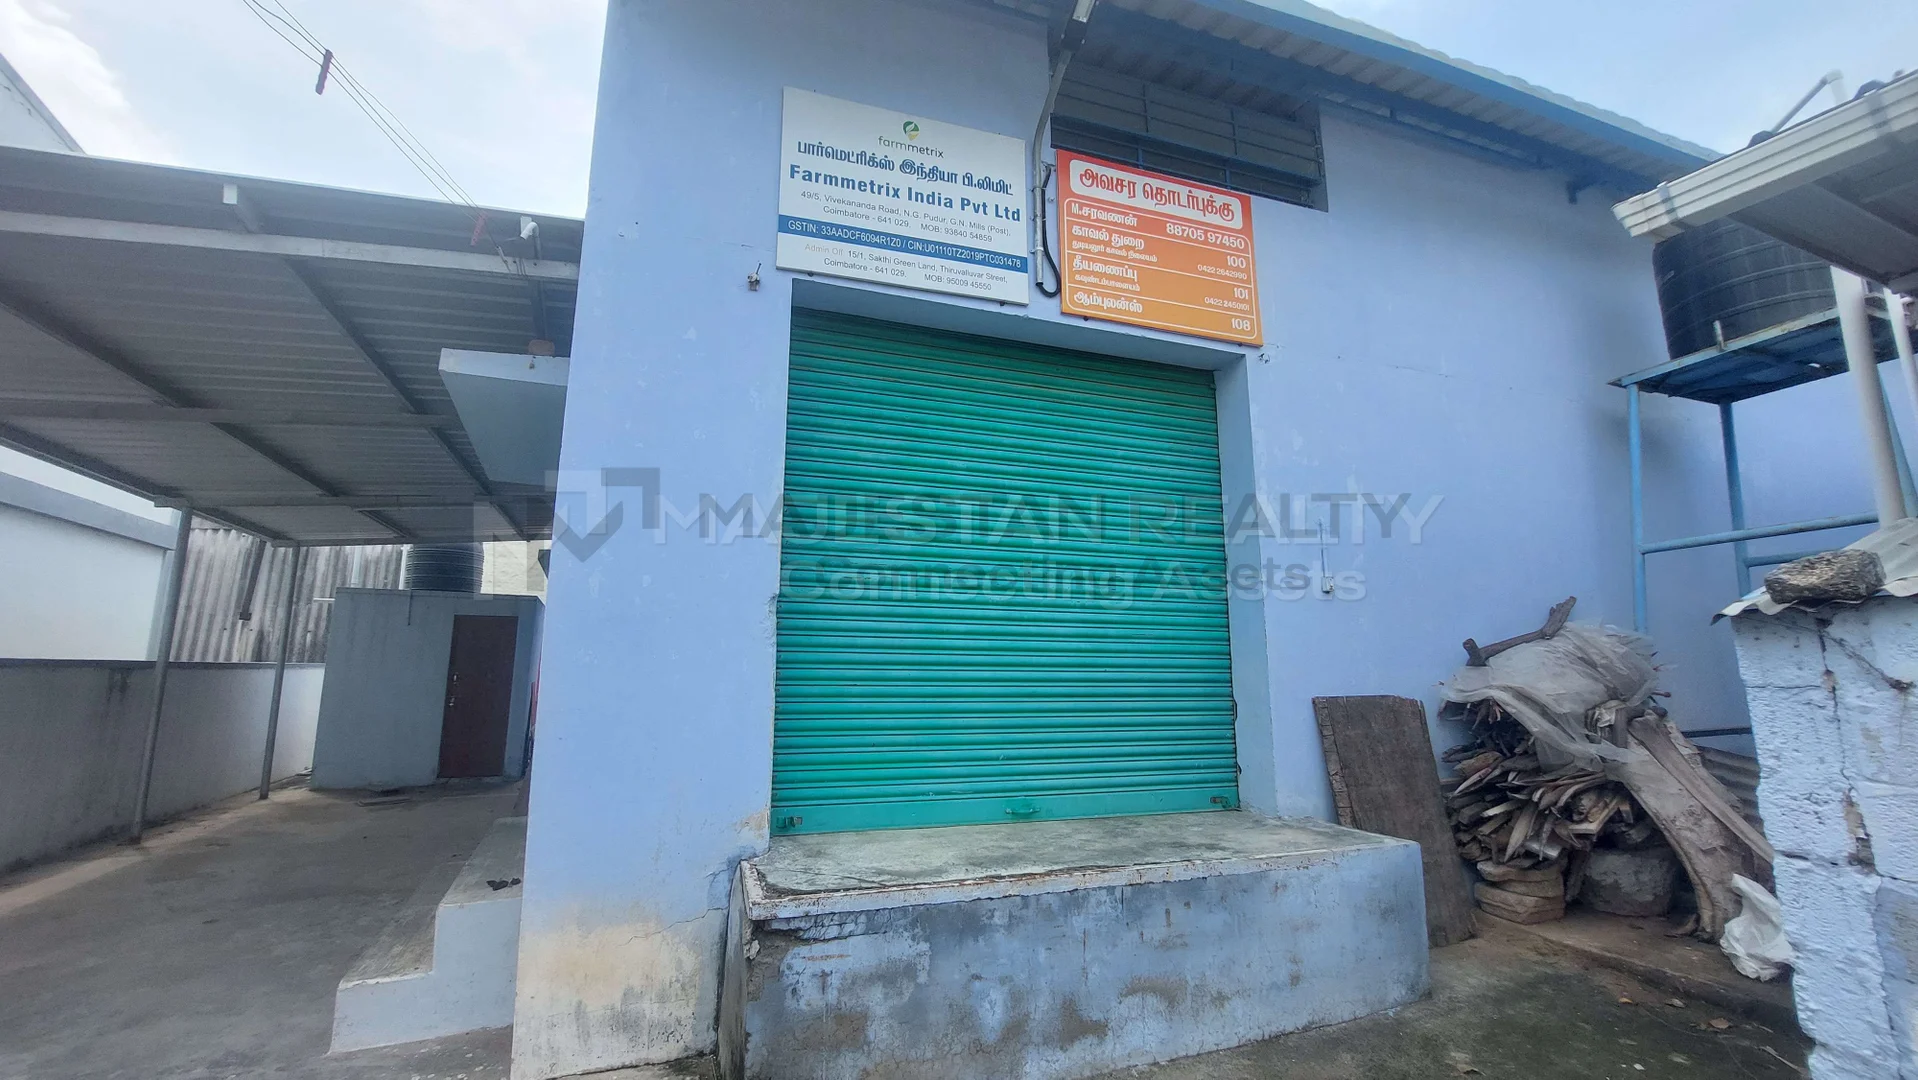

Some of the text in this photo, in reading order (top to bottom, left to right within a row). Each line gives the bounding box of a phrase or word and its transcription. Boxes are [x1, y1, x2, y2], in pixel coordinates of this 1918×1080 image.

[878, 136, 944, 158] farmmetrix
[899, 159, 958, 184] இந்தியா
[789, 164, 1021, 222] Farmmetrix India Pvt Ltd
[1080, 168, 1235, 222] அவசர தொடர்புக்கு
[801, 190, 822, 202] 49/5,
[824, 195, 876, 211] Vivekananda
[878, 204, 901, 216] Road,
[969, 221, 986, 231] Mills
[788, 220, 819, 233] GSTIN:
[823, 206, 870, 221] Coimbatore
[877, 216, 892, 224] 641
[920, 223, 942, 233] MOB:
[970, 231, 993, 242] 54859
[1072, 224, 1145, 250] காவல் துறை
[1166, 223, 1245, 249] 88705 97450
[804, 243, 831, 254] Admin
[868, 253, 892, 264] Sakthi
[893, 258, 916, 268] Green
[940, 264, 984, 279] Thiruvalluvar
[824, 257, 868, 272] Coimbatore
[875, 265, 888, 274] 641
[924, 273, 945, 283] MOB:
[946, 276, 969, 287] 95009
[970, 280, 992, 291] 45550
[1073, 255, 1138, 282] தீயணைப்பு
[1197, 264, 1216, 274] 0422
[1227, 255, 1246, 269] 100
[1204, 296, 1223, 306] 0422
[1233, 287, 1249, 300] 101
[1231, 317, 1251, 331] 108
